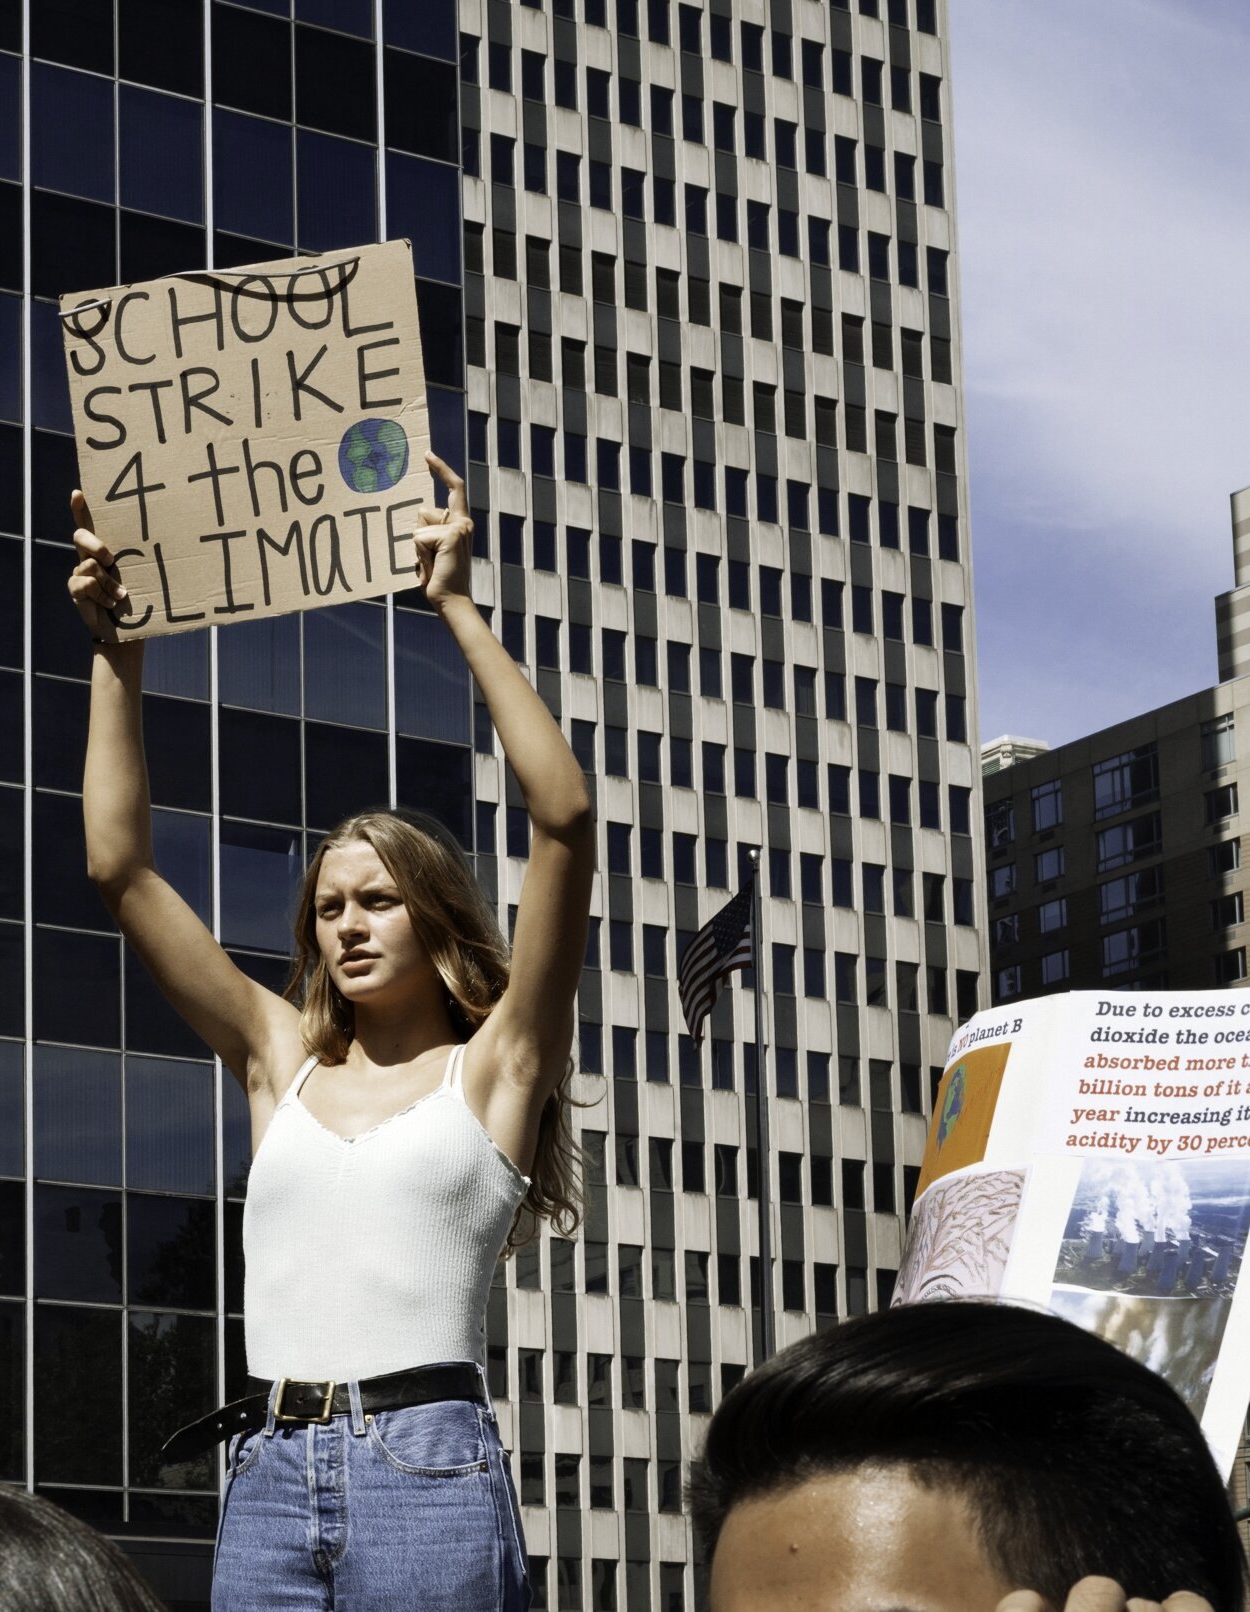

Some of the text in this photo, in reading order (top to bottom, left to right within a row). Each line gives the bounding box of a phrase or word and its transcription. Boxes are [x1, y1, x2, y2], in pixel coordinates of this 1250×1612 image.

[69, 265, 394, 376] SCHOOL
[83, 337, 404, 450] STRIKE
[105, 438, 325, 541] 4 the
[1095, 1001, 1137, 1017] Due
[1143, 1003, 1163, 1018] to
[1169, 1004, 1236, 1018] excess
[968, 1021, 1009, 1048] planet
[1011, 1018, 1023, 1034] B
[1090, 1026, 1170, 1045] dioxide
[1175, 1029, 1209, 1045] the
[1084, 1053, 1180, 1071] absorbed
[1185, 1057, 1236, 1071] more
[1078, 1078, 1147, 1096] billion
[1153, 1082, 1198, 1098] tons
[1203, 1080, 1225, 1097] of
[1226, 1079, 1241, 1096] it
[1070, 1108, 1120, 1124] year
[1124, 1106, 1233, 1127] increasing
[1066, 1131, 1141, 1153] acidity
[1146, 1135, 1173, 1154] by
[1177, 1134, 1203, 1151] 30
